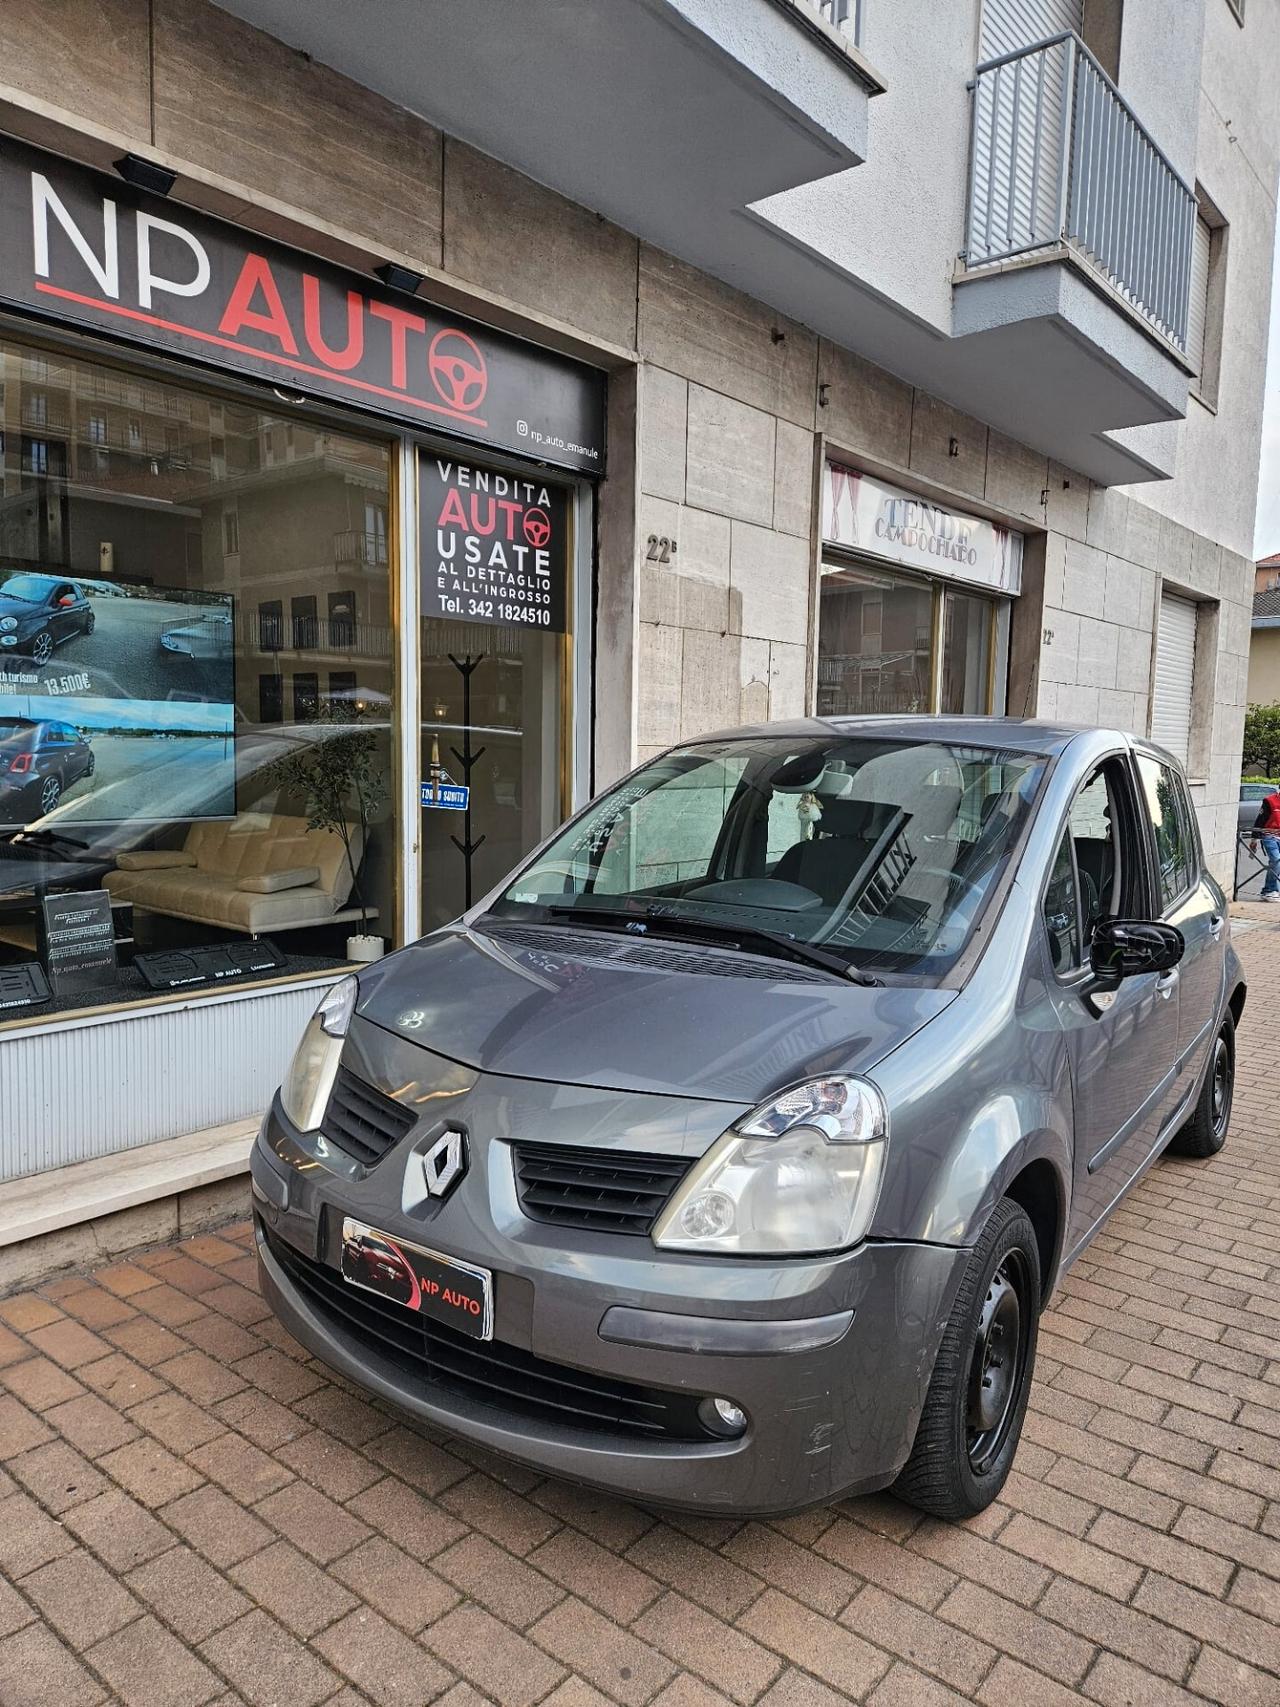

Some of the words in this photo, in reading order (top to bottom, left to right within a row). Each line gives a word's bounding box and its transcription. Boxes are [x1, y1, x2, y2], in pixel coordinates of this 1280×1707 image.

[31, 171, 211, 310] NP
[437, 460, 551, 508] VENDITA
[437, 529, 551, 577] USATE
[875, 517, 977, 566] CAMPOCHIARO
[437, 576, 445, 589] E
[452, 580, 551, 604] ALL'INGROSSO
[438, 561, 458, 576] AL
[467, 565, 551, 591] DETTAGLIO
[438, 594, 464, 614] Tel.
[468, 599, 494, 619] 342
[497, 603, 551, 626] 1824510
[8, 672, 38, 684] turismo
[44, 673, 91, 696] 13.500€
[225, 968, 242, 977] AUTO
[421, 1277, 440, 1296] NP
[442, 1288, 481, 1316] AUTO
